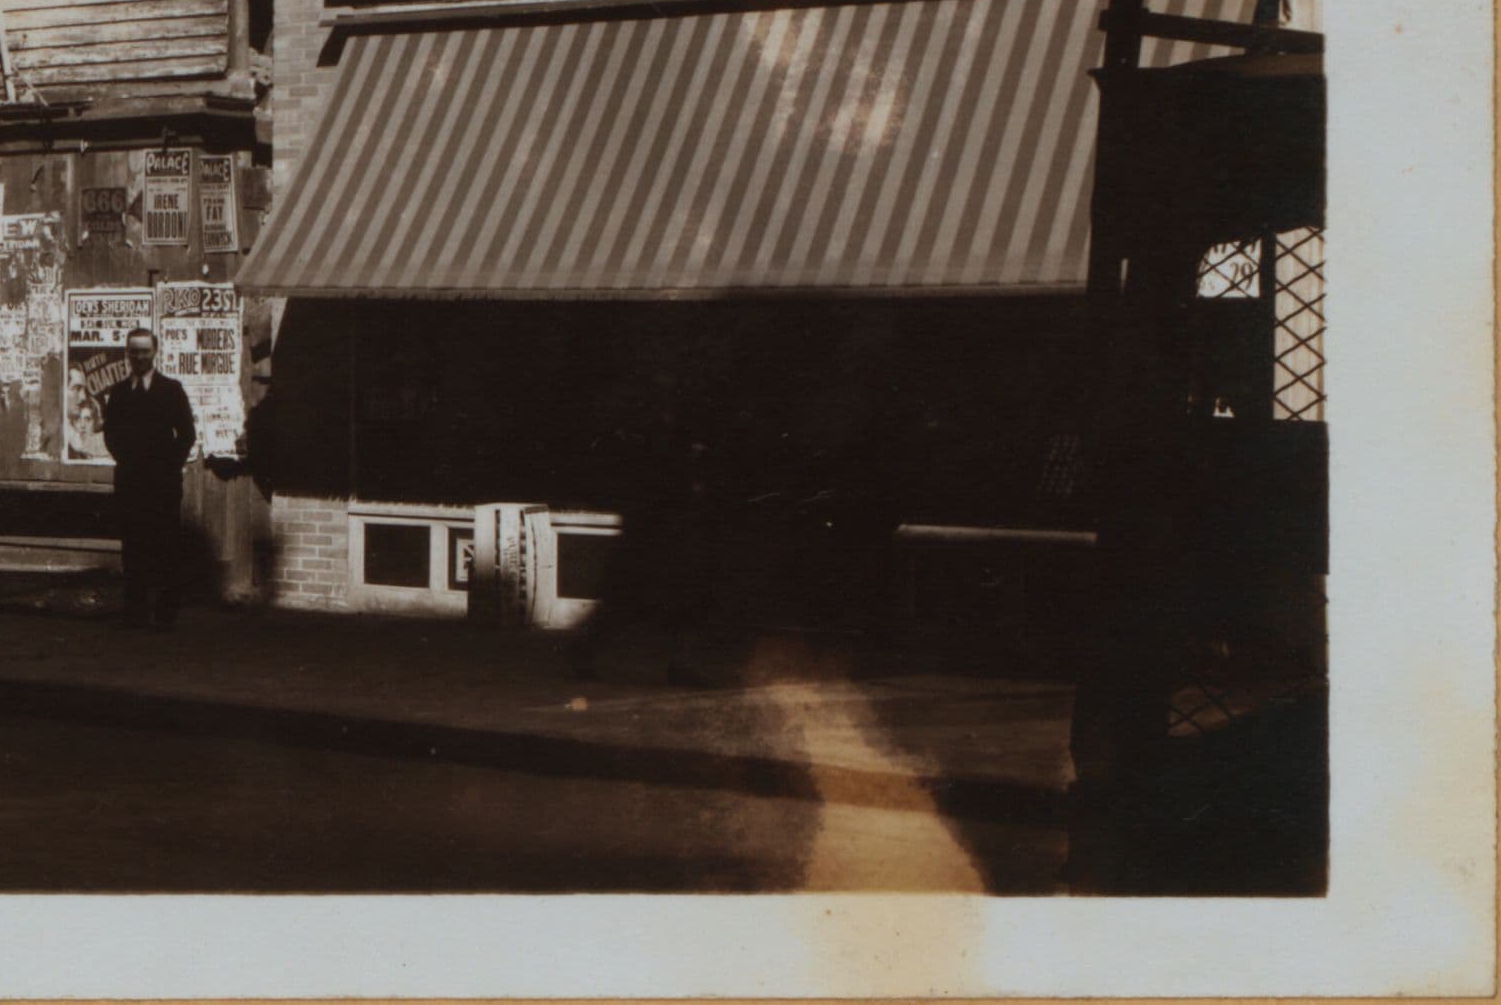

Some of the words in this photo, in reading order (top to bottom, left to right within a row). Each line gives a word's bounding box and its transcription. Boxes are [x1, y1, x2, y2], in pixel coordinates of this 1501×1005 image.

[146, 153, 189, 175] PALACE
[154, 193, 180, 210] IRENE
[206, 205, 224, 221] FAY
[162, 287, 200, 314] RKO
[70, 331, 104, 342] MAR.
[165, 329, 187, 341] POE'S
[179, 352, 199, 375] RUE
[200, 352, 236, 375] MORGUE
